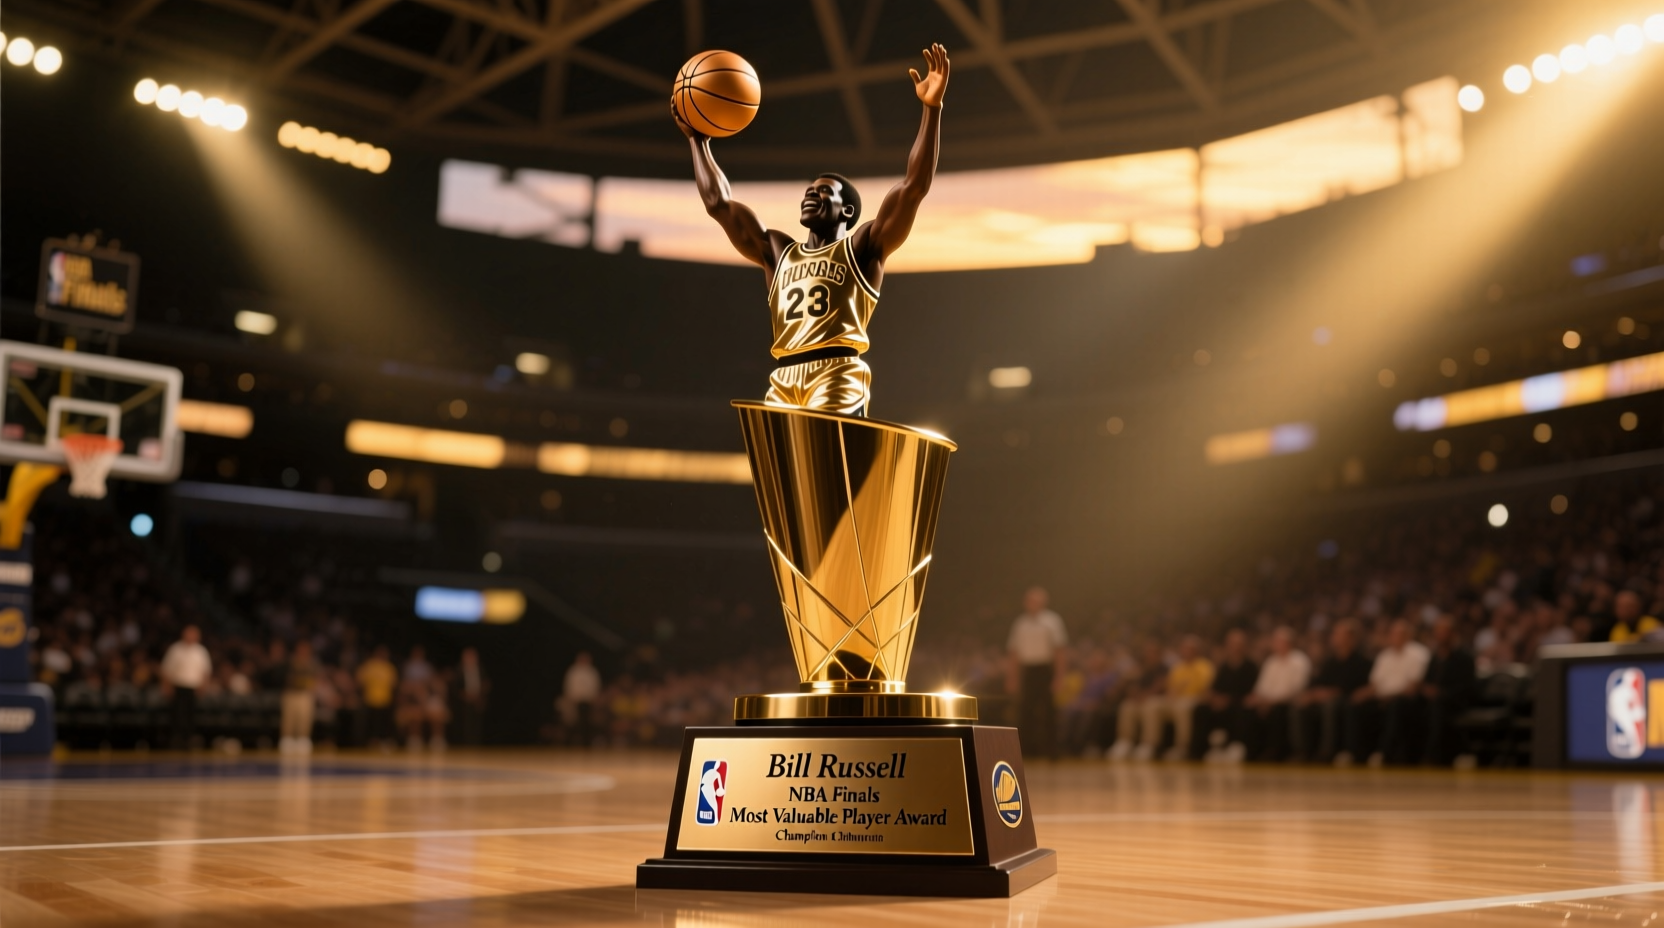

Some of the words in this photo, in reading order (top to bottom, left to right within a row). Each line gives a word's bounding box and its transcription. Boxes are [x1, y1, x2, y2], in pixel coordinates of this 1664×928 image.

[785, 284, 830, 321] 23
[766, 752, 812, 779] Bill
[816, 752, 907, 779] Russell
[788, 786, 828, 803] NBA
[833, 786, 880, 803] Finals
[729, 807, 769, 824] Most
[773, 807, 839, 824] Valuable
[842, 808, 892, 830] Player
[894, 808, 947, 826] Award
